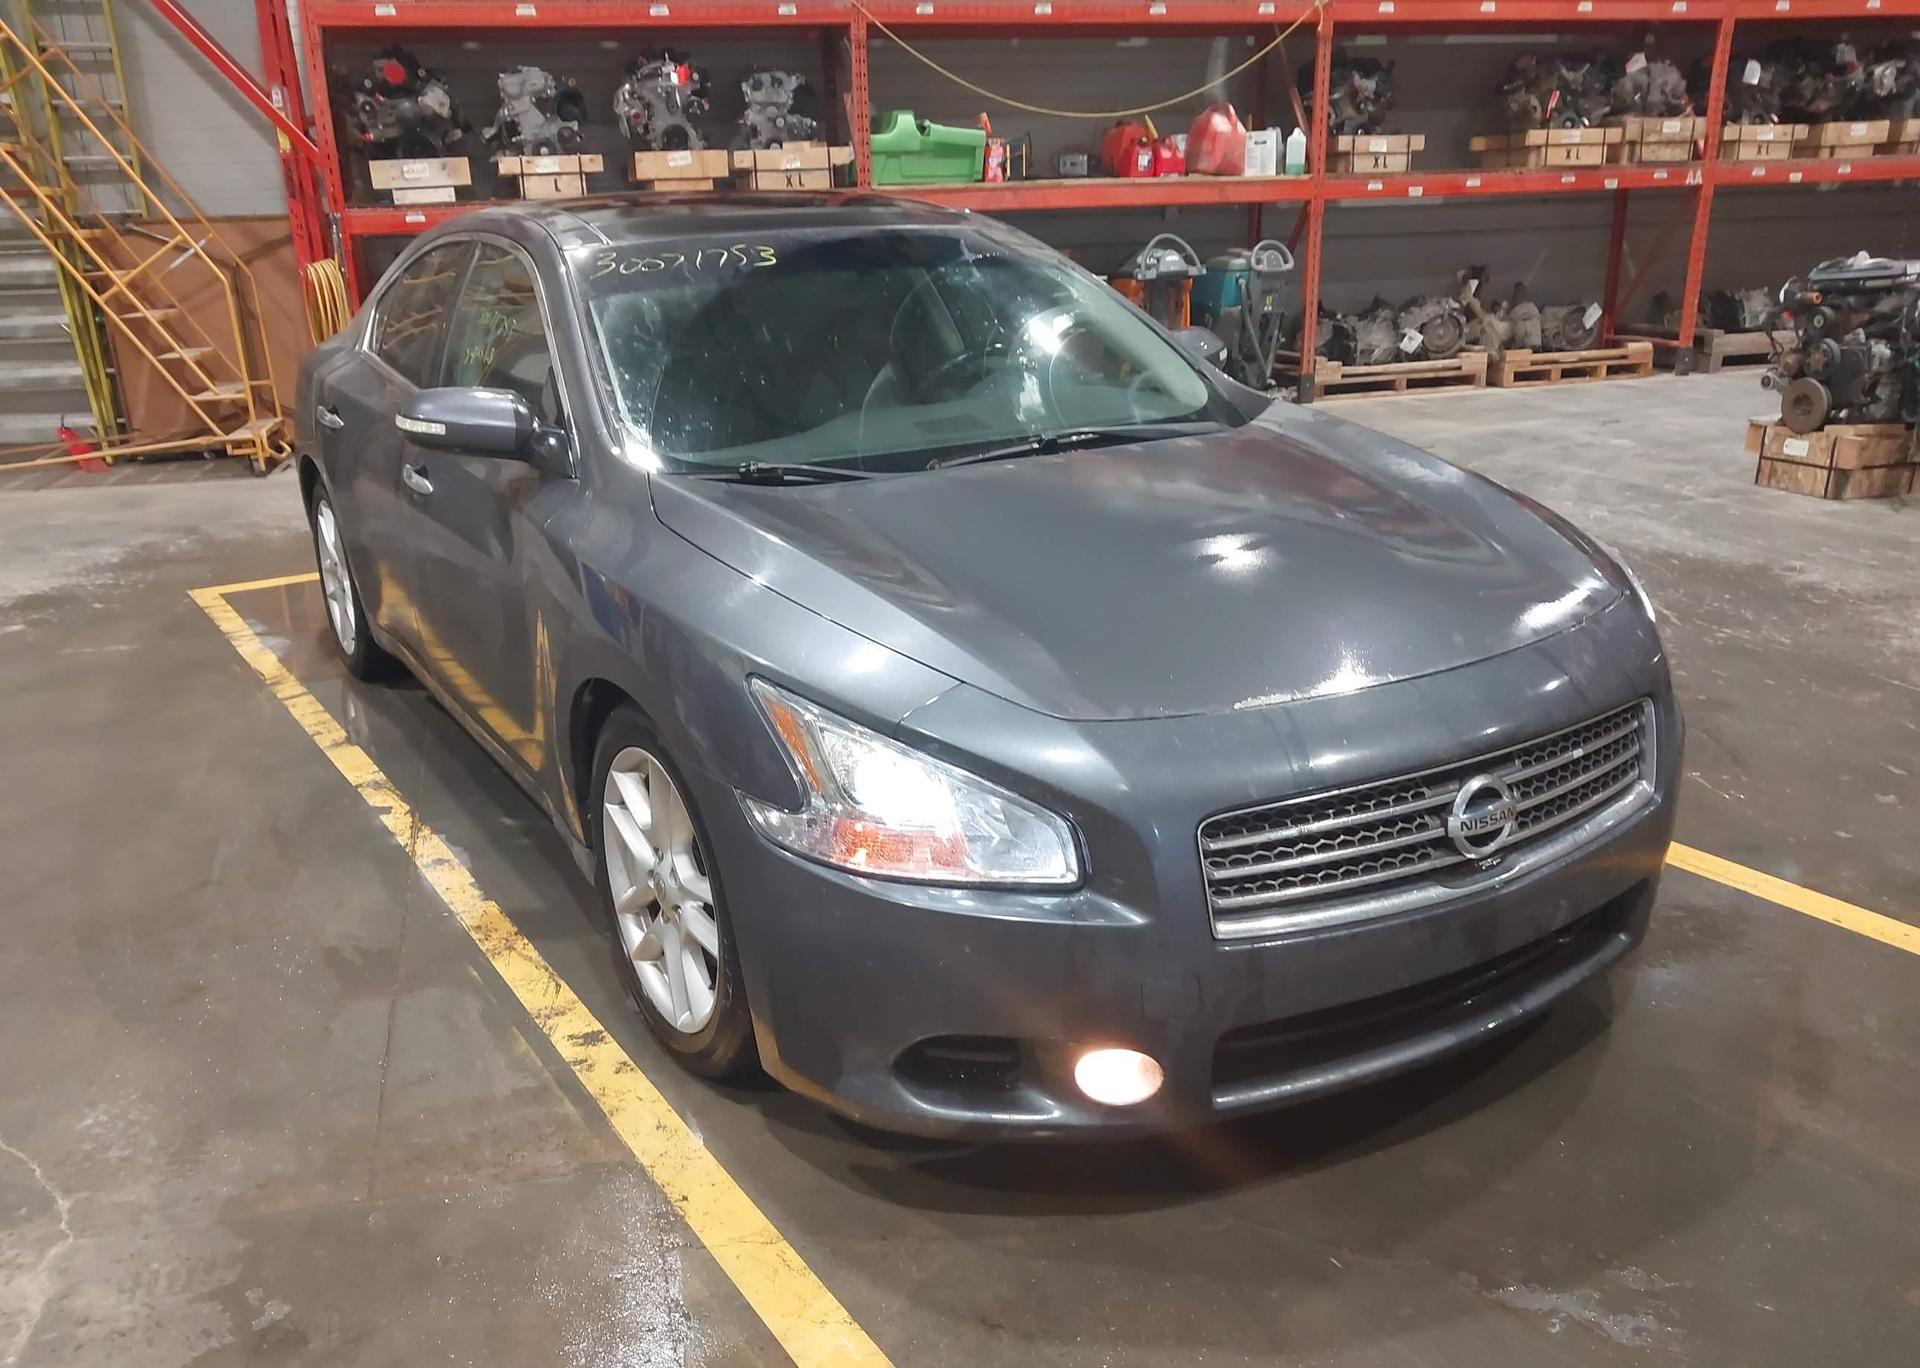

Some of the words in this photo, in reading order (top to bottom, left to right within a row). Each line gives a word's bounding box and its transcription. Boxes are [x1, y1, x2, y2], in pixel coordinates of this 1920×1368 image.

[1373, 154, 1388, 169] XL
[785, 173, 805, 188] XL
[1459, 807, 1515, 832] NISSAN
